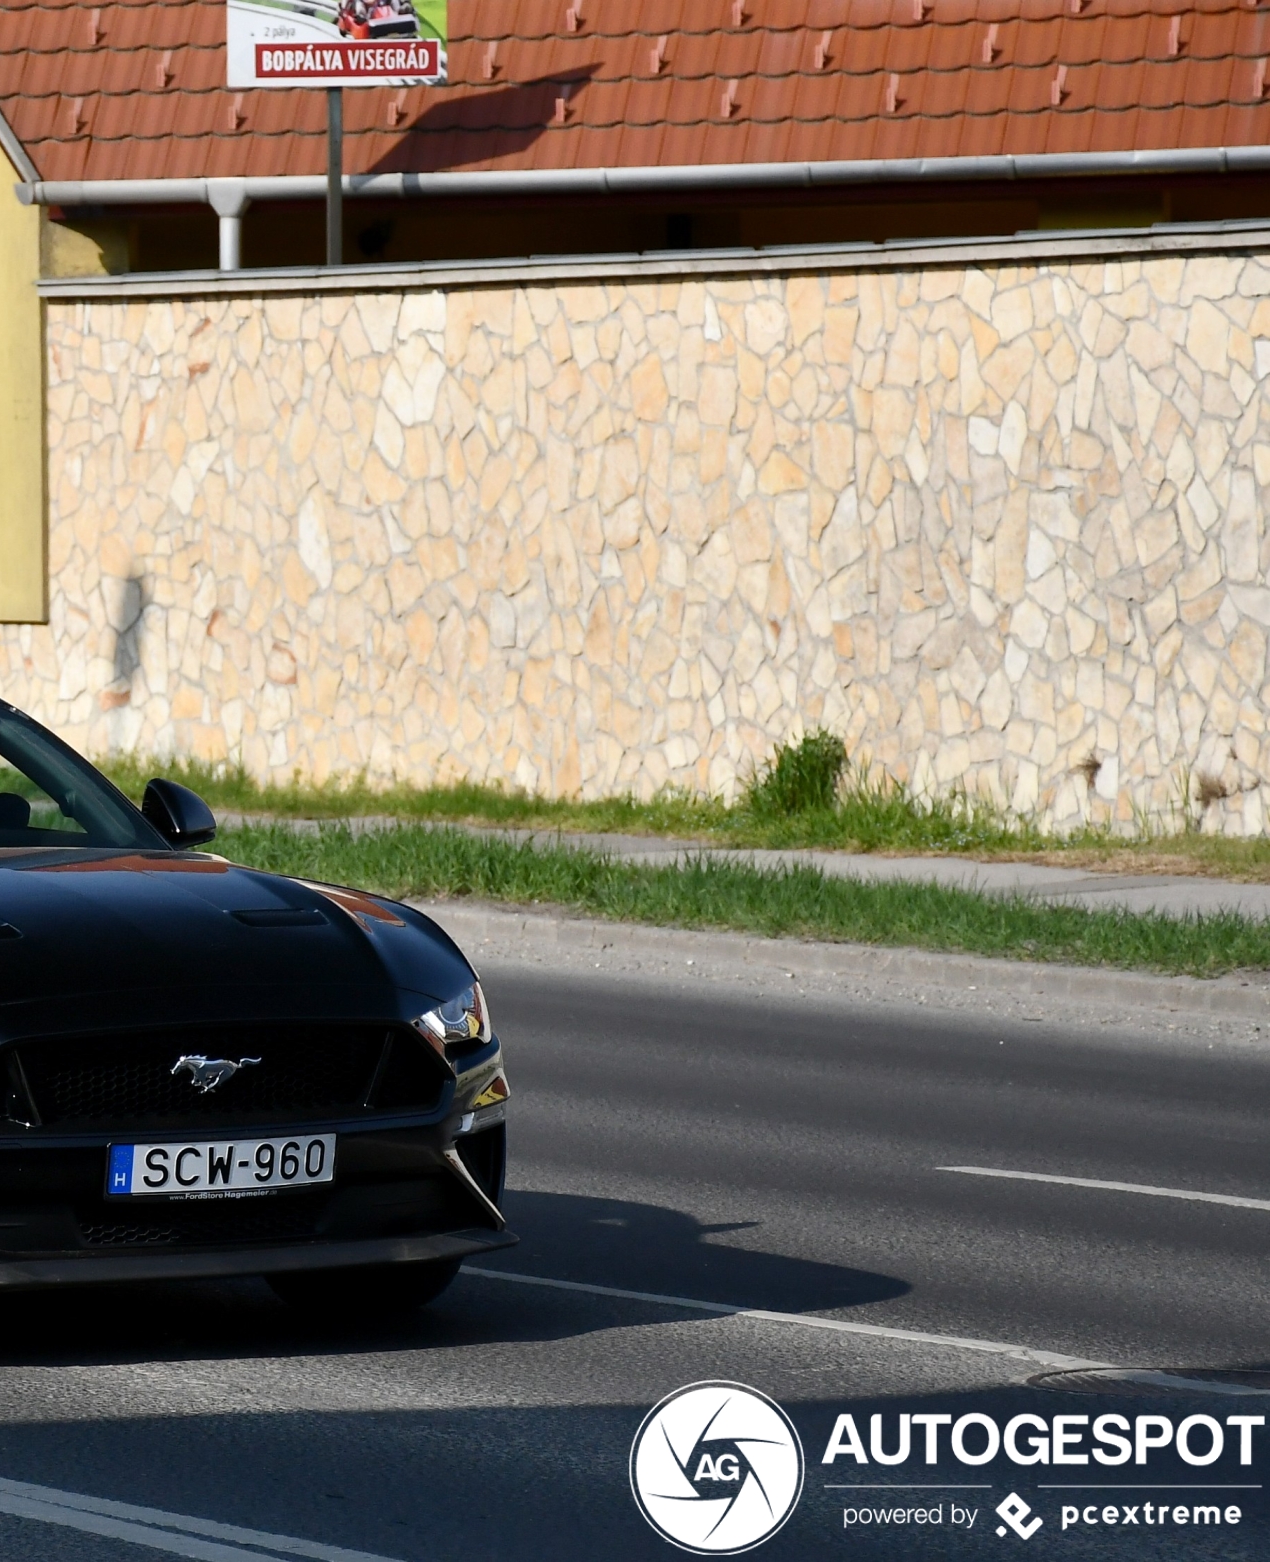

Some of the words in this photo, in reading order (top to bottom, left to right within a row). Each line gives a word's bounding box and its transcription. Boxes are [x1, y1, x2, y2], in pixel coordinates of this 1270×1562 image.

[261, 44, 343, 72] BOBPÁLYA
[348, 43, 430, 71] VISEGRÁD
[142, 1139, 326, 1188] SCW-960
[114, 1173, 126, 1187] H
